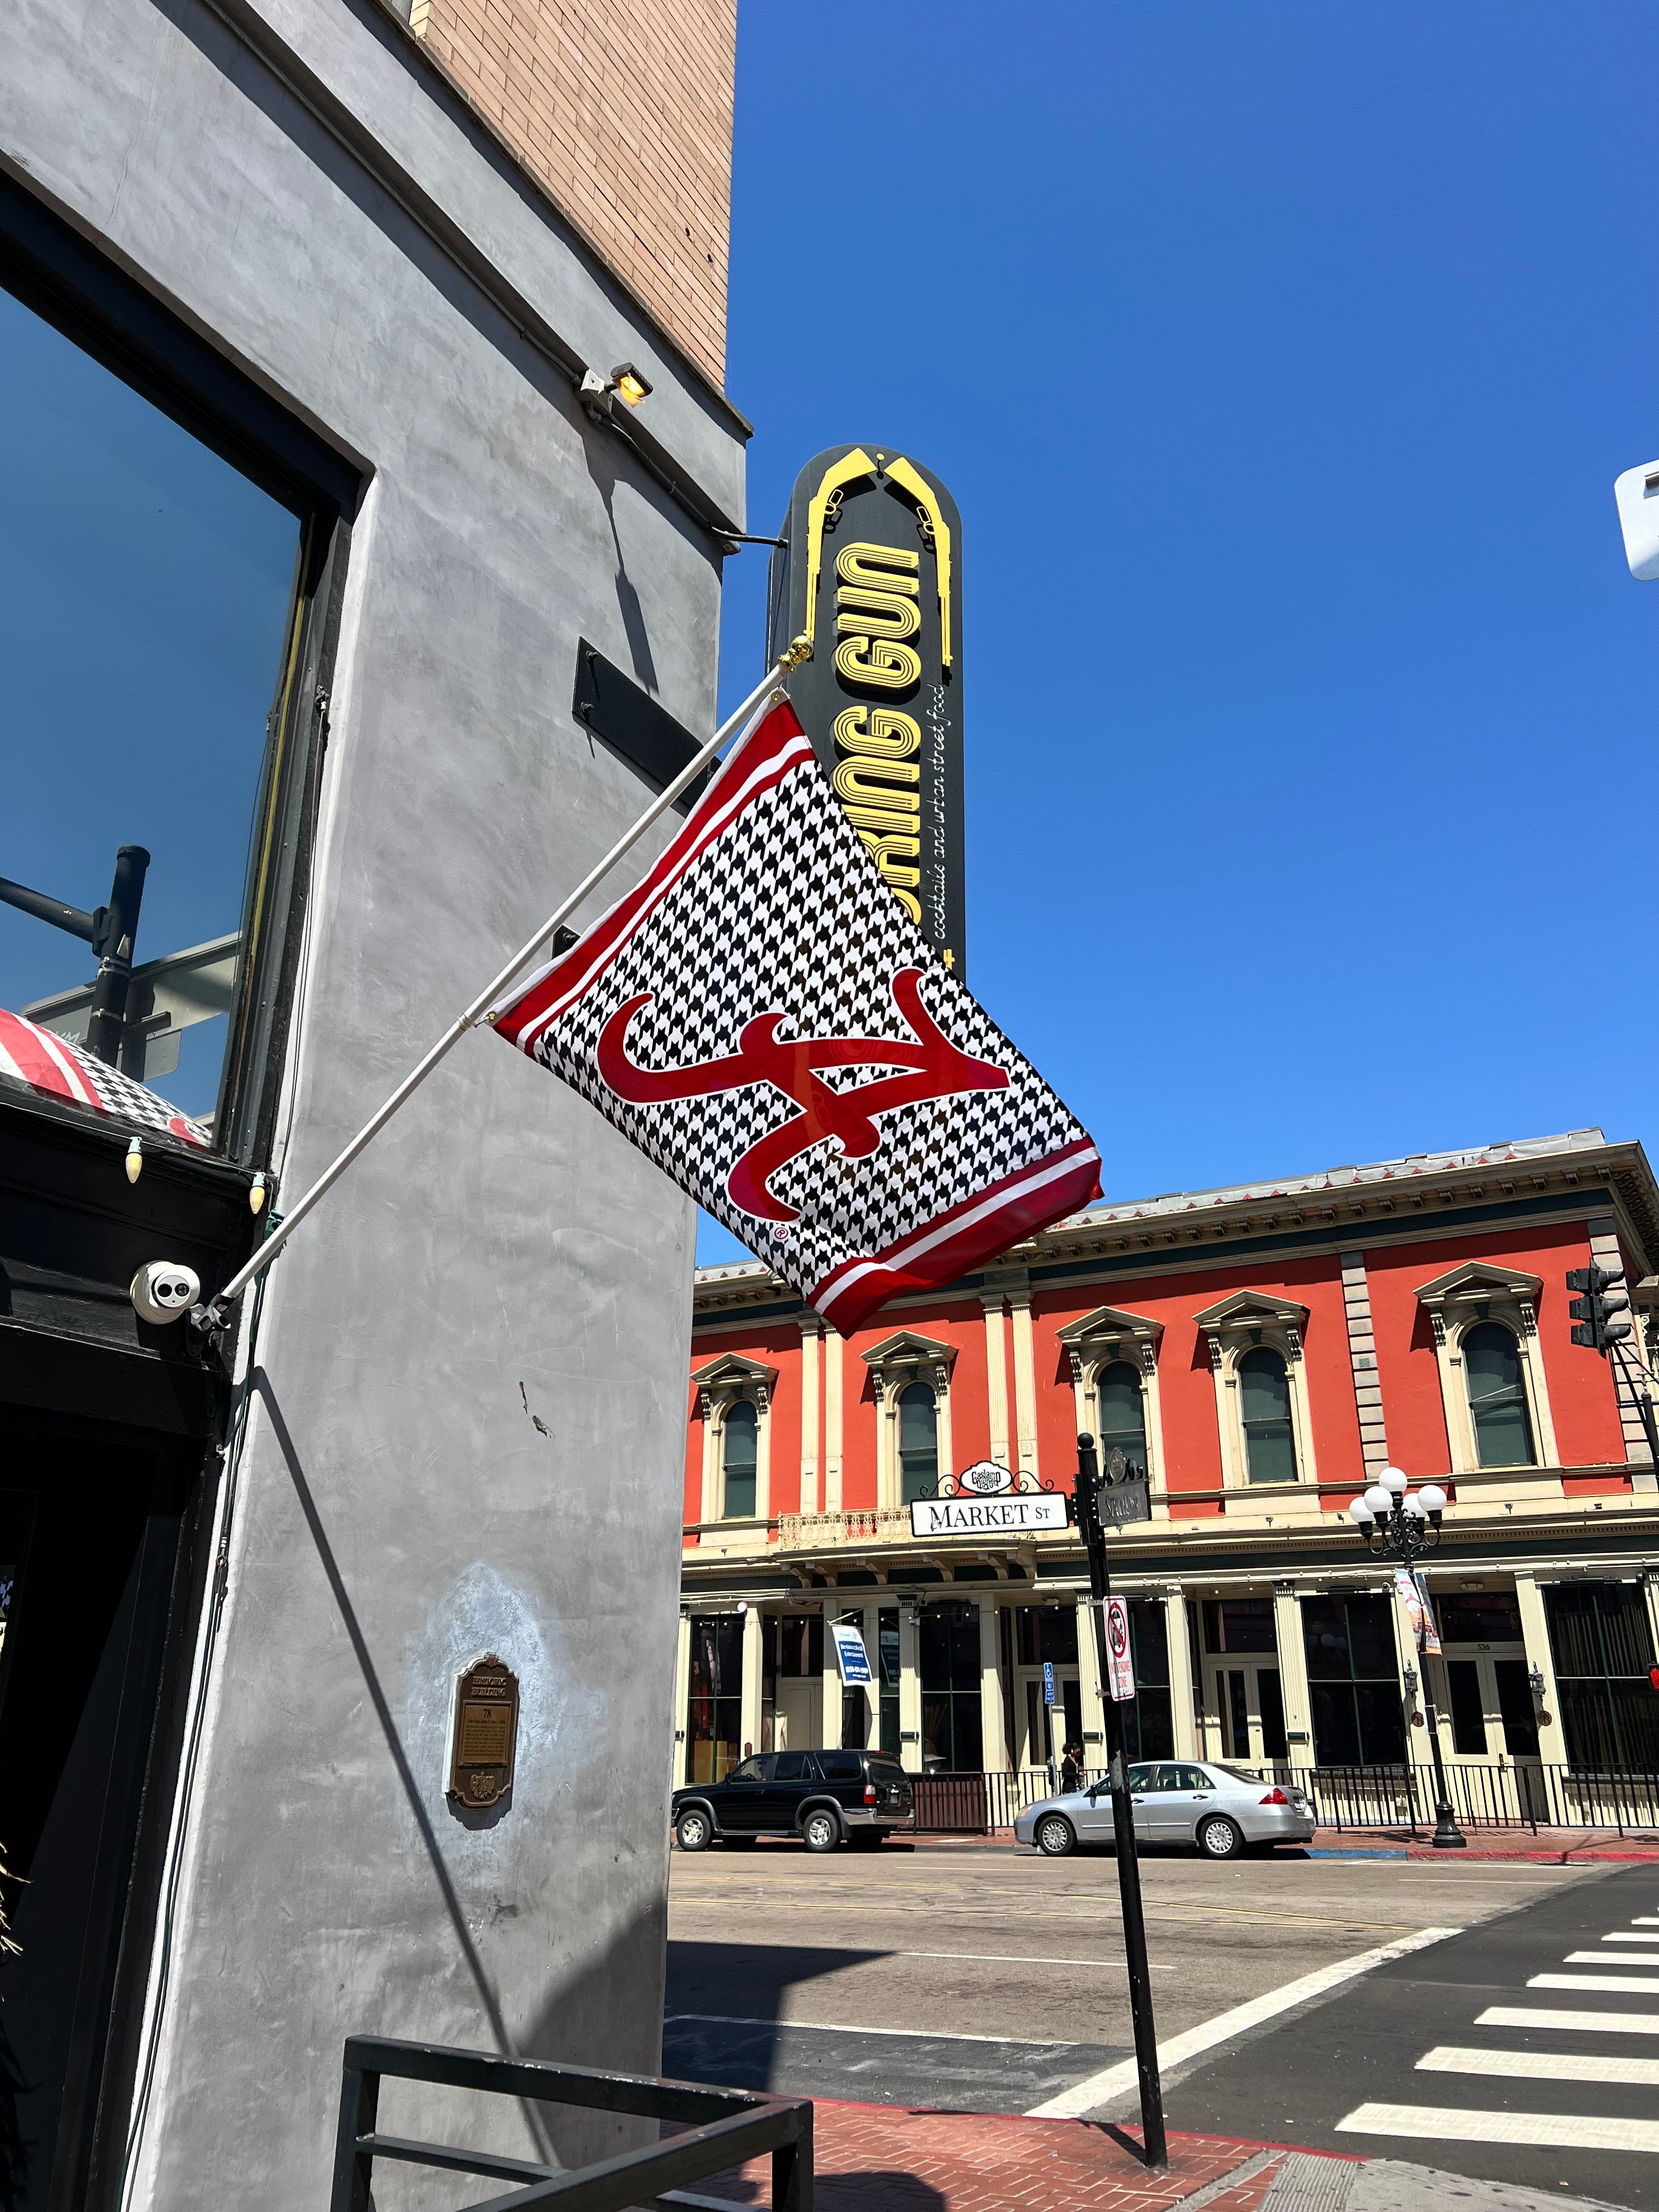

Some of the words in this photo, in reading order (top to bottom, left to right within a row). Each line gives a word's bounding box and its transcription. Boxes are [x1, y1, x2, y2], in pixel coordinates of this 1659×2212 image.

[836, 542, 922, 689] GUN
[926, 682, 952, 726] food
[926, 724, 945, 773] street
[833, 706, 922, 925] KING
[926, 775, 945, 823] urban
[927, 825, 945, 859] and
[926, 863, 945, 939] cocktails
[928, 1504, 1029, 1532] MARKET
[1035, 1506, 1050, 1519] ST
[483, 1708, 492, 1719] 78
